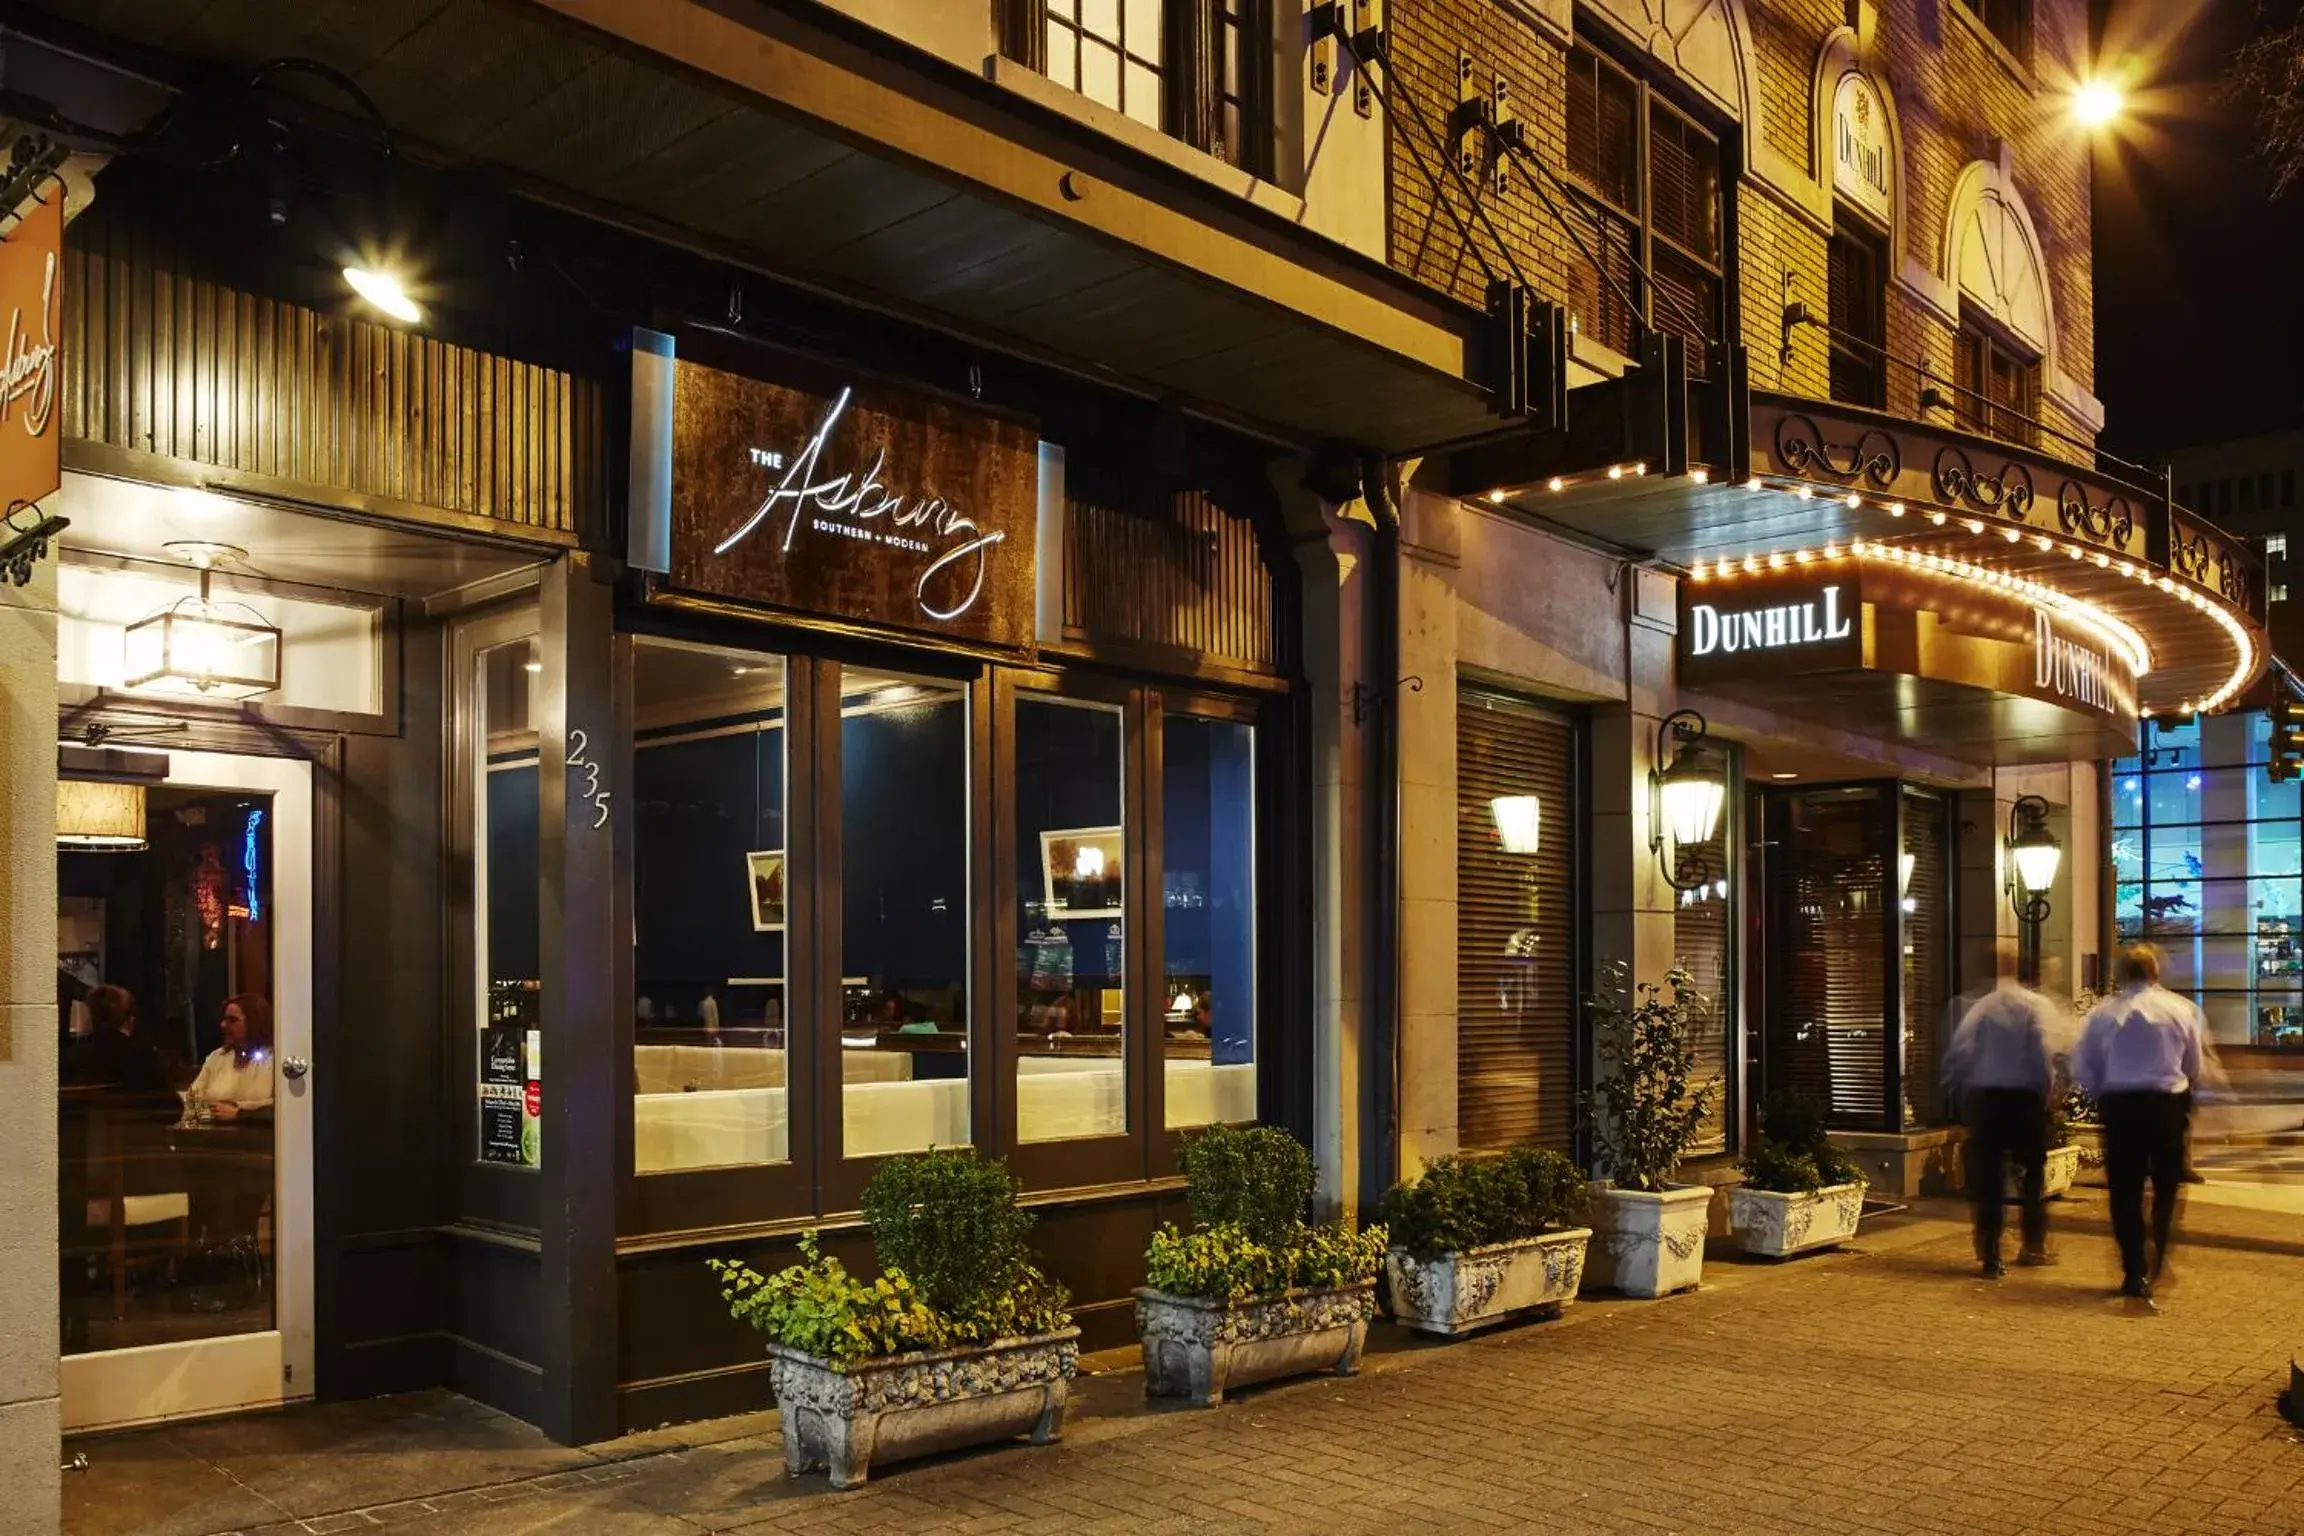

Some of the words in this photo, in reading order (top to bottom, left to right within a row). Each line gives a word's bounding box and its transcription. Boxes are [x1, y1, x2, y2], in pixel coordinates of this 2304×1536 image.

[1839, 111, 1887, 196] DUNHILL
[750, 448, 783, 470] THE
[714, 386, 1005, 620] Asbury
[813, 518, 872, 541] SOUTHERN
[885, 535, 929, 552] MODERN
[1692, 585, 1850, 656] DUNHILL
[2033, 605, 2115, 714] DUNHILL
[566, 729, 611, 829] 235
